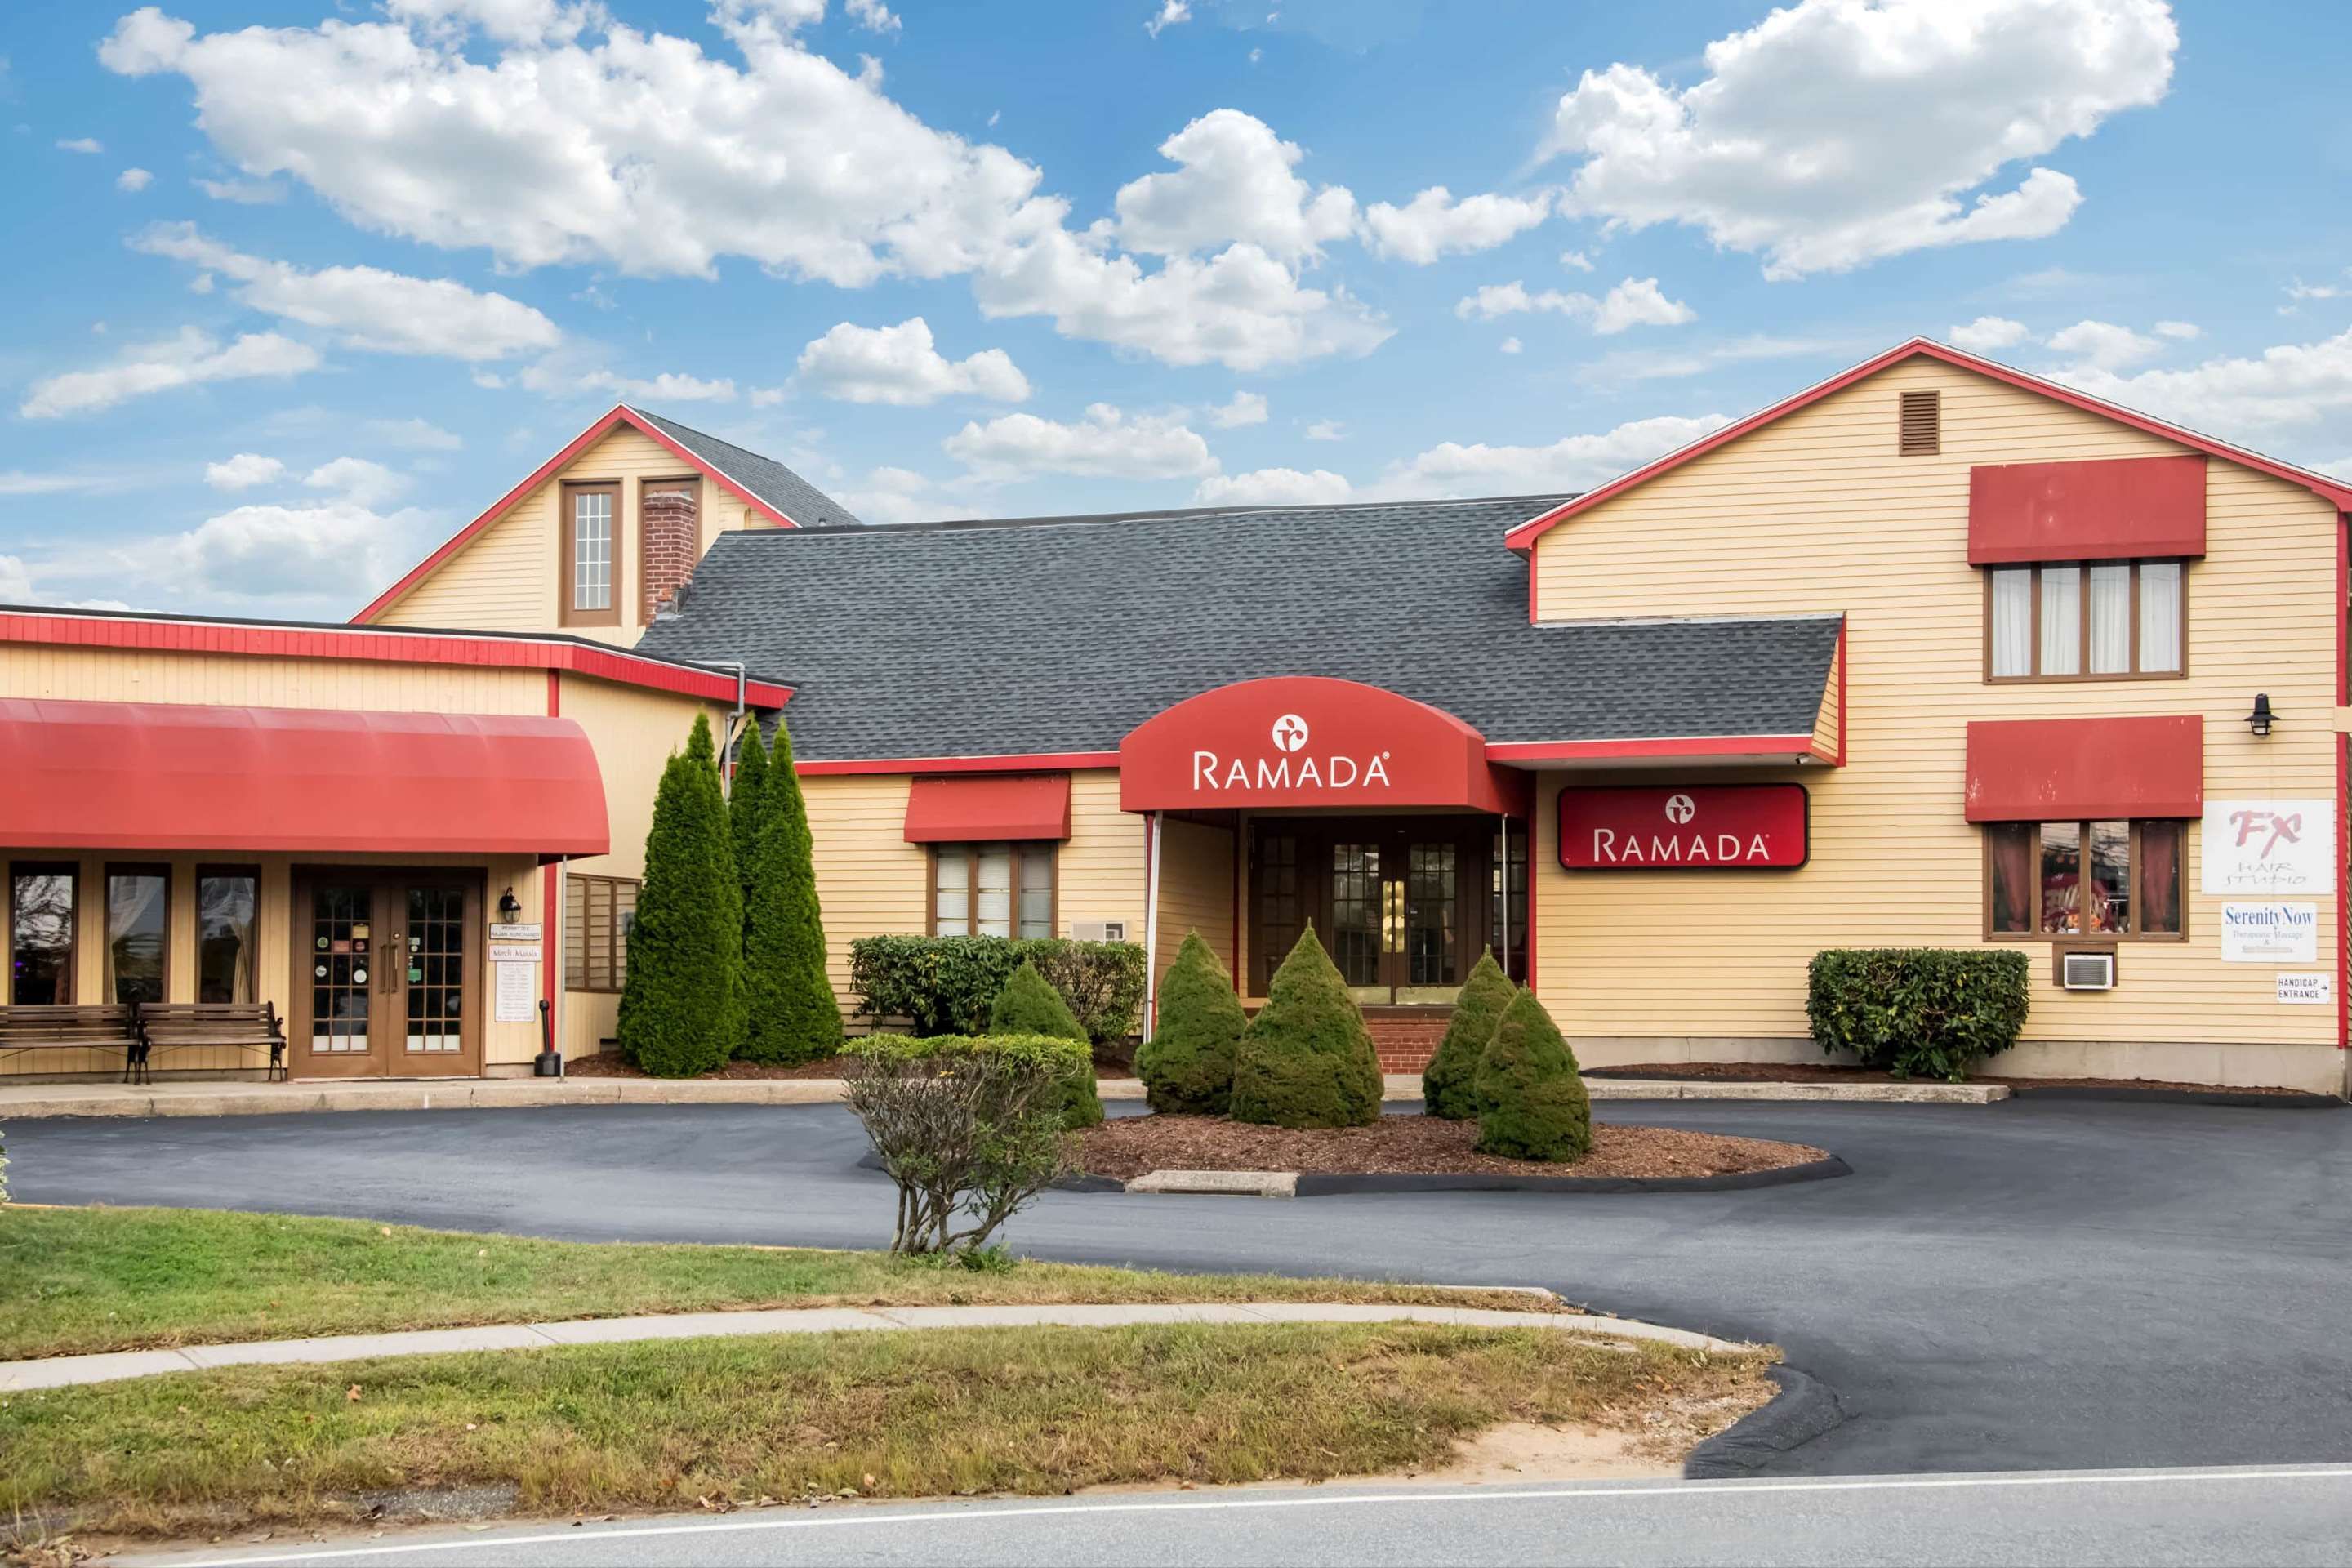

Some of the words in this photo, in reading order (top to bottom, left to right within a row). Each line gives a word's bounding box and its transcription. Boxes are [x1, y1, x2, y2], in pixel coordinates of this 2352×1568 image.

[1193, 751, 1390, 791] RAMADA
[1593, 828, 1770, 862] RAMADA
[2238, 862, 2294, 873] HAIR
[2226, 873, 2307, 885] STUDIO
[2225, 906, 2281, 930] Serenity
[2281, 906, 2313, 925] Now
[2274, 930, 2303, 940] Massage
[2278, 978, 2318, 987] HANDICAP
[2278, 989, 2320, 999] ENTRANCE
